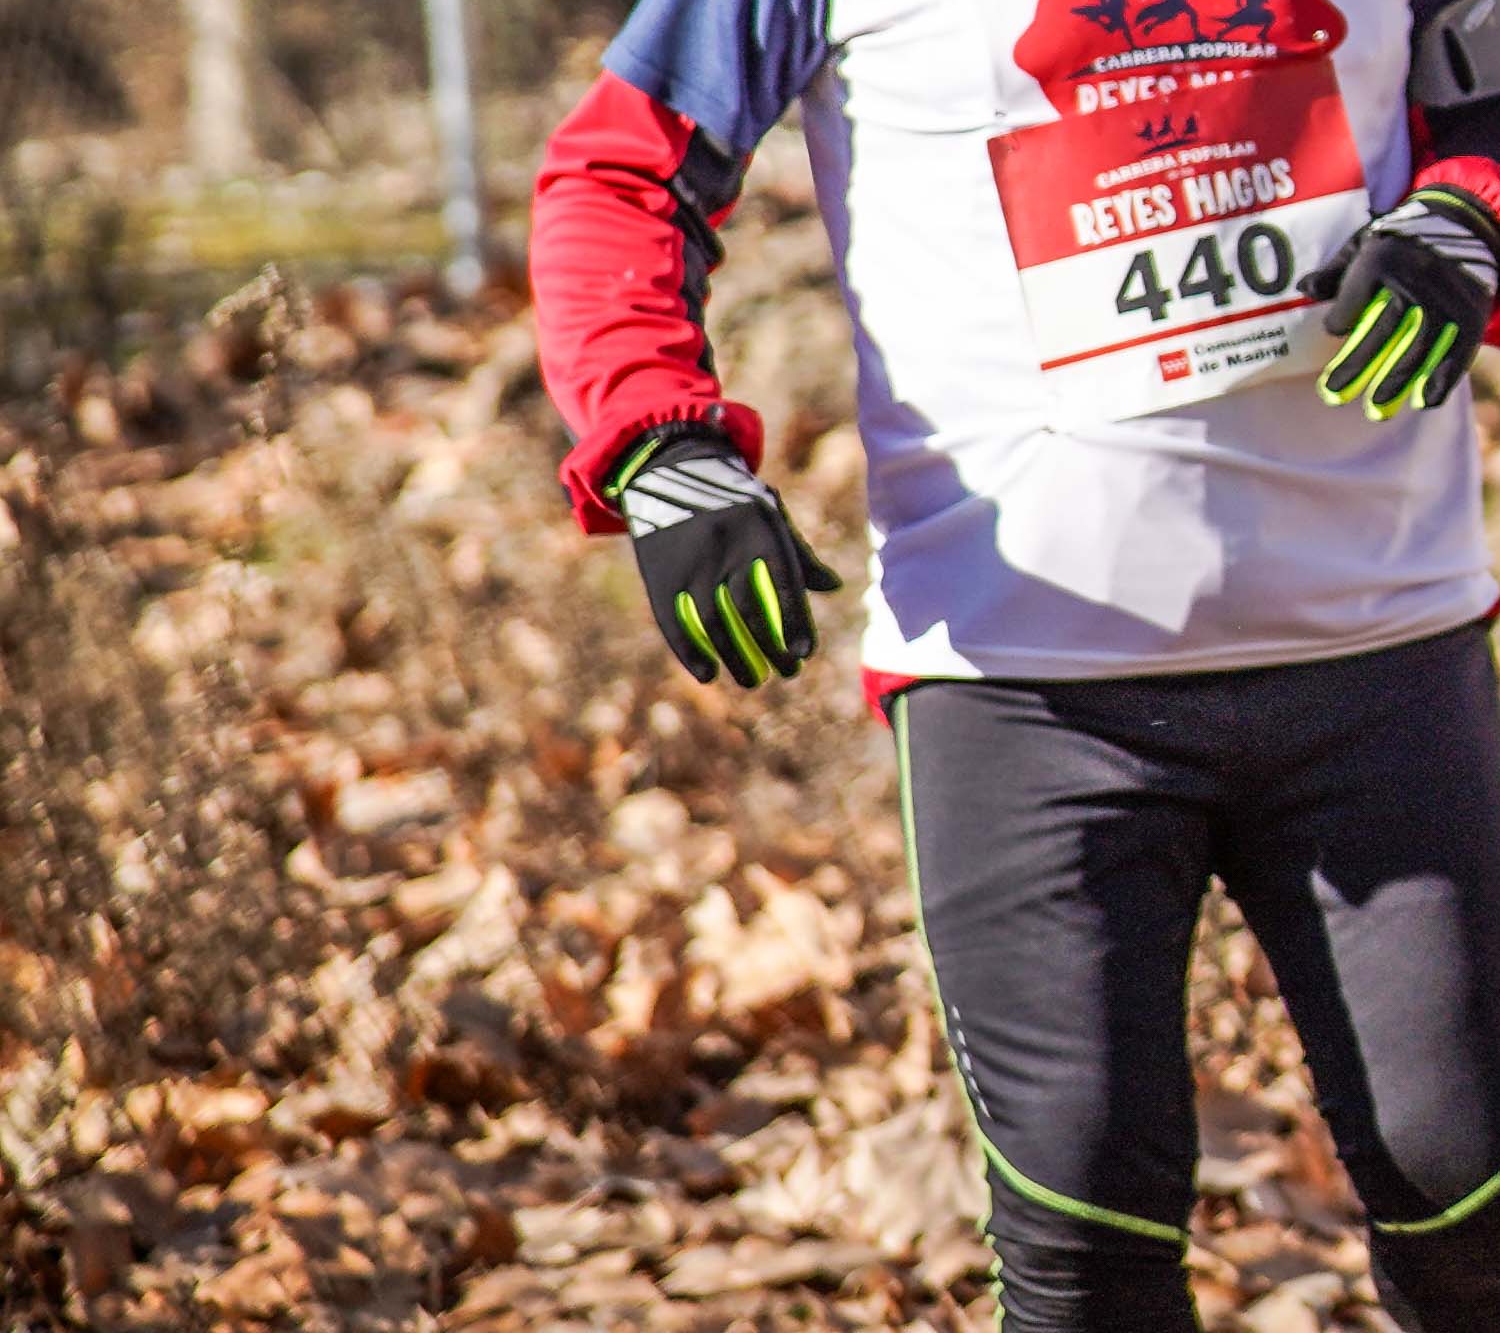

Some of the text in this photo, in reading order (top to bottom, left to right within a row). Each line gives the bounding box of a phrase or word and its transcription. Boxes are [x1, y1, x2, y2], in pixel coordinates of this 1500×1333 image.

[1094, 45, 1184, 72] CARRERA
[1189, 42, 1278, 59] POPULAR
[1095, 154, 1177, 188] CARRERA
[1070, 157, 1296, 247] REYES MAGOS
[1115, 221, 1296, 322] 440
[1226, 343, 1290, 367] Madrid
